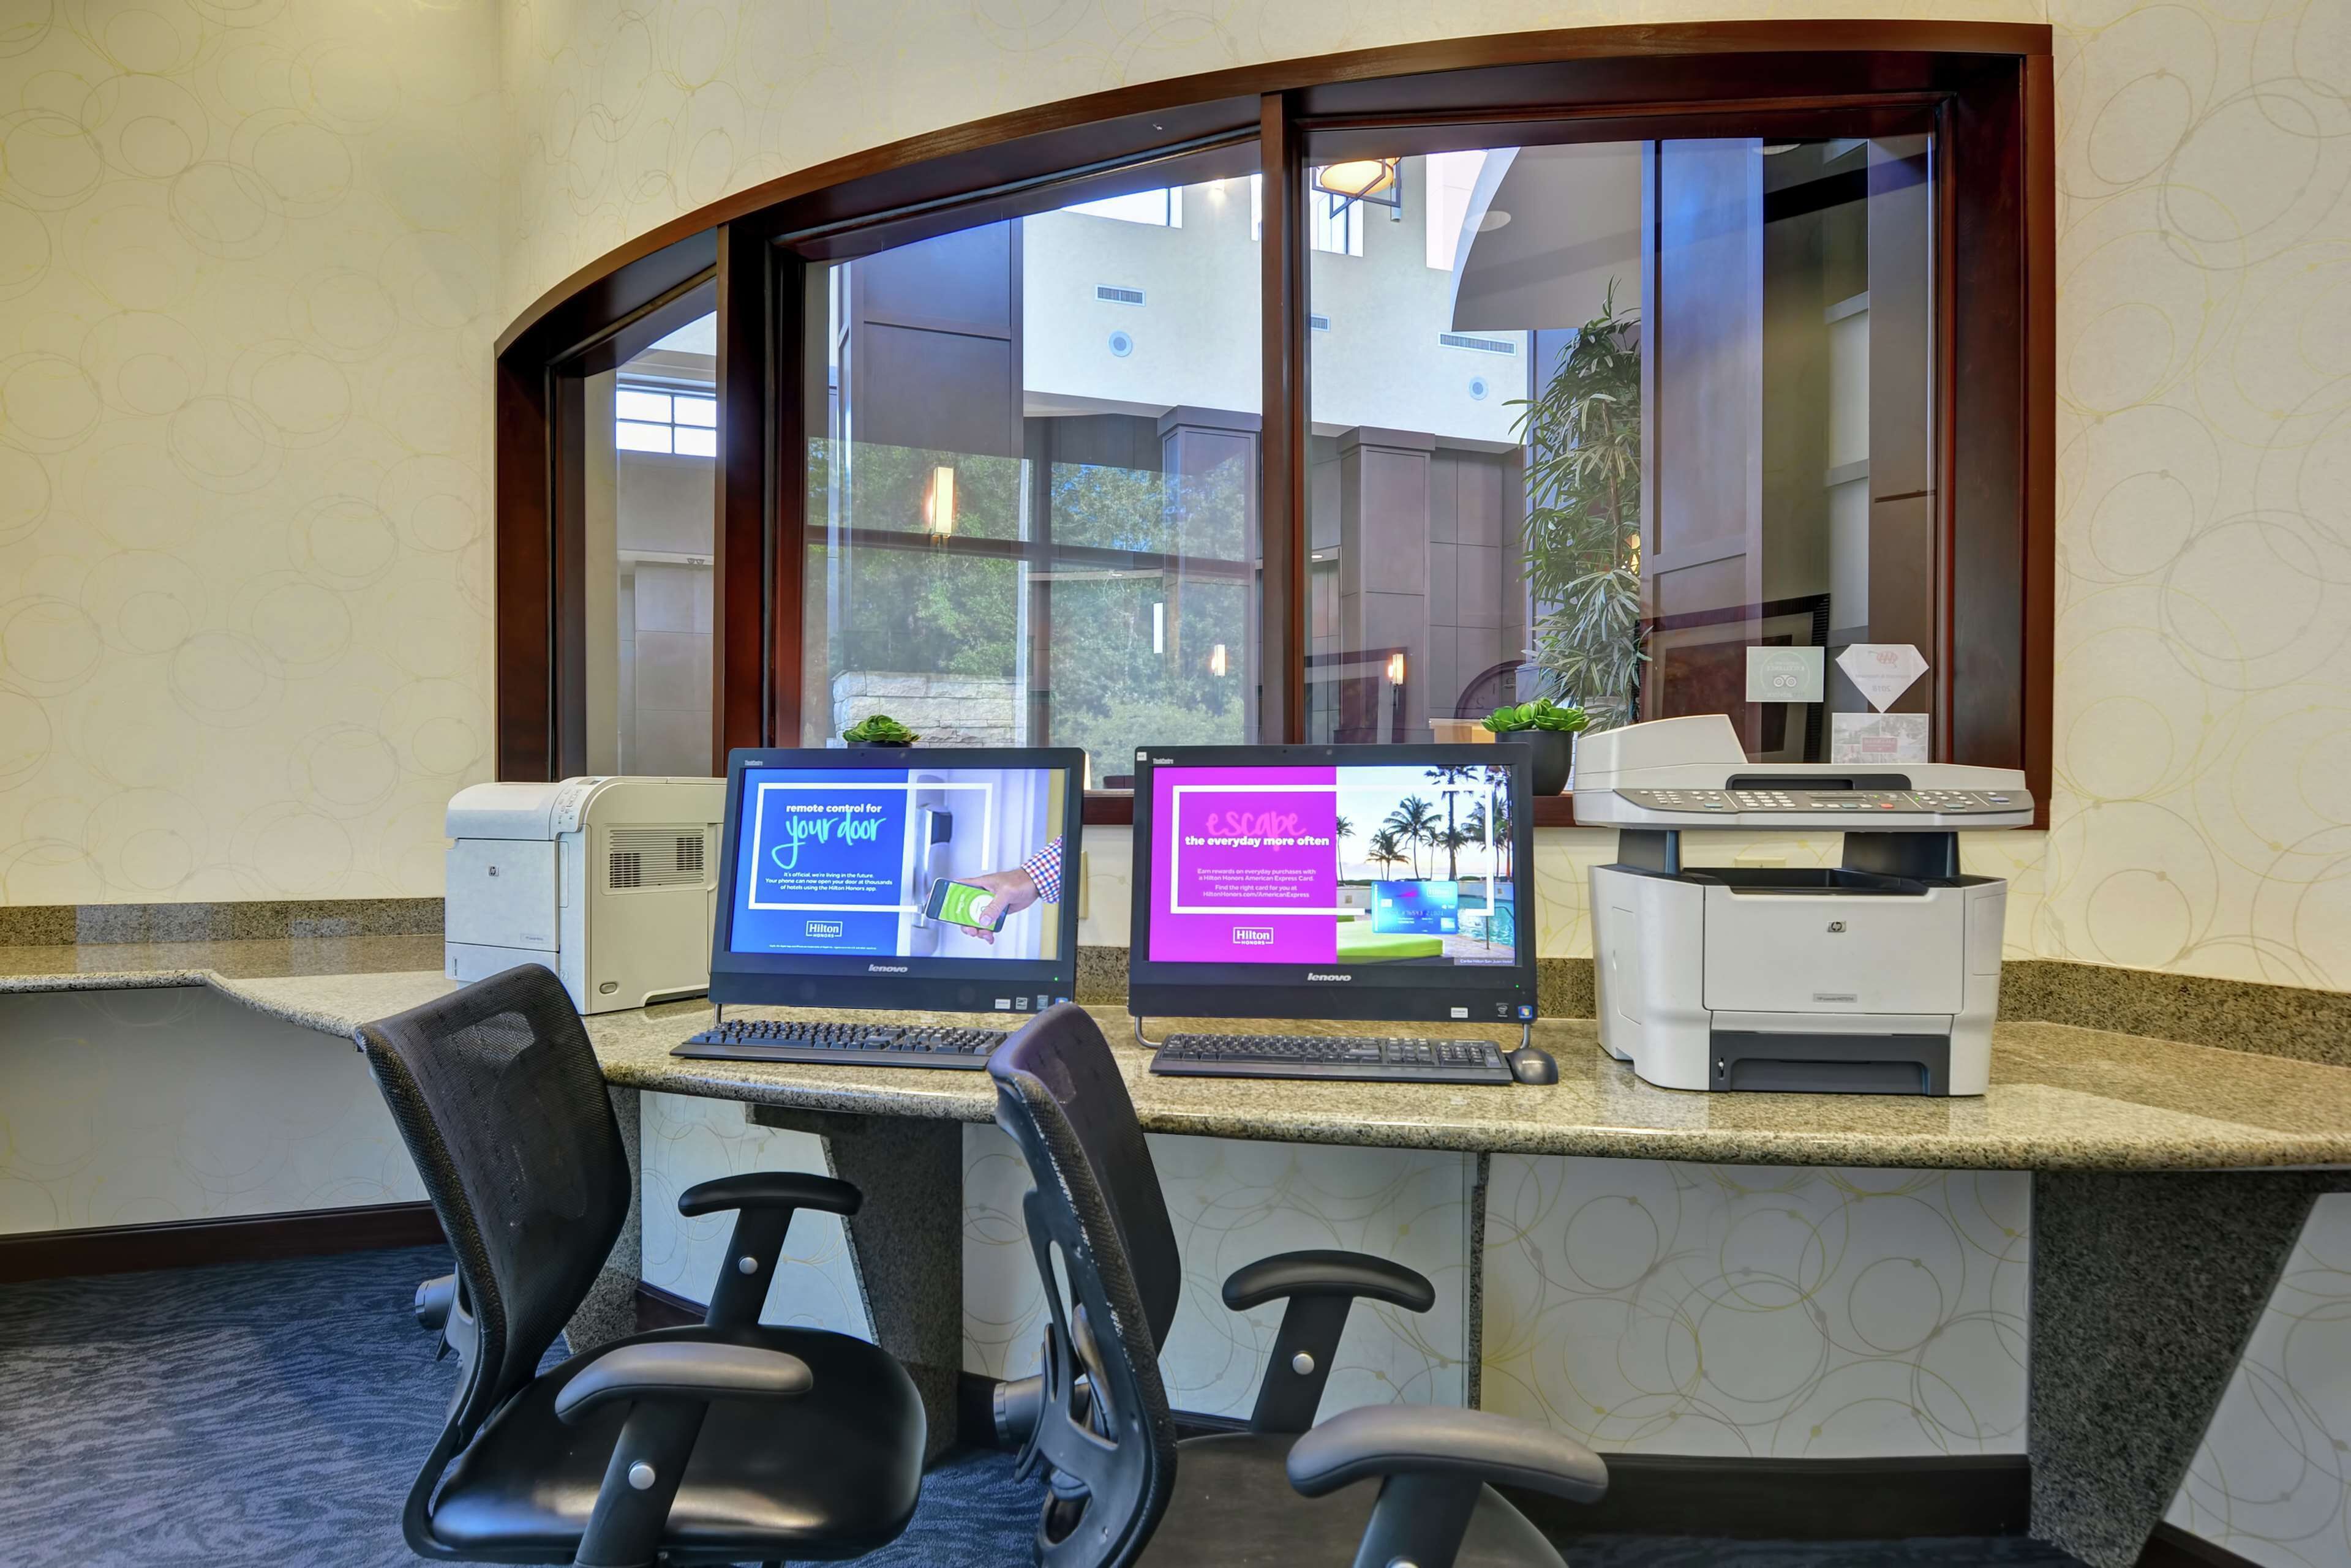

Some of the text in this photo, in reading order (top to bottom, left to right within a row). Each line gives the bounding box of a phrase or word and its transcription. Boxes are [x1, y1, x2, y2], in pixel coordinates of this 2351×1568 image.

[786, 803, 882, 813] remote control for
[1206, 811, 1306, 852] escape
[772, 810, 887, 869] your door
[1185, 836, 1205, 846] the
[1207, 836, 1261, 847] everyday
[1297, 836, 1330, 846] often
[809, 923, 839, 933] Hilton
[1236, 929, 1270, 940] Hilton
[868, 964, 908, 972] lenovo
[1307, 972, 1352, 981] lenovo
